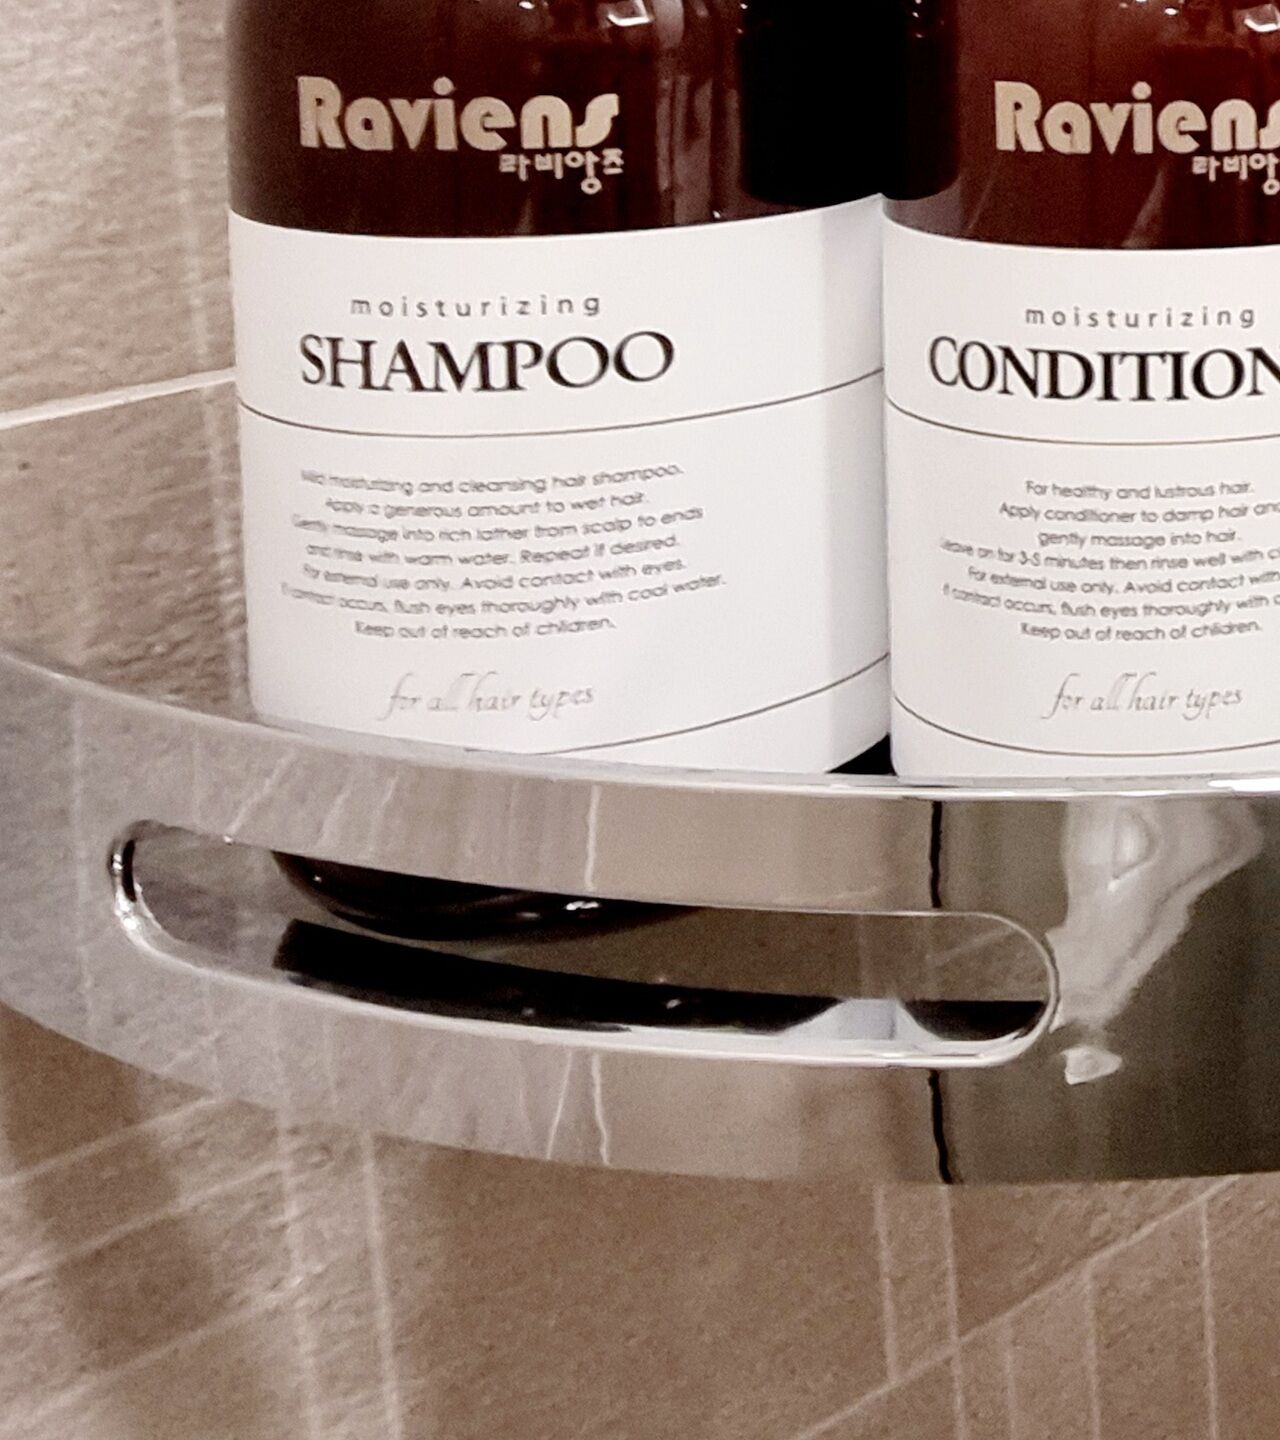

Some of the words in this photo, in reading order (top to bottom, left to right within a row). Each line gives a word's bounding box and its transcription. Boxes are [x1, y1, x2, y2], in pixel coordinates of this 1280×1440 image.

[298, 76, 620, 151] Raviens
[499, 148, 625, 195] 라비앙즈
[350, 294, 601, 318] moisturizing
[1026, 305, 1256, 329] moisturizing
[299, 330, 675, 393] SHAMPOO
